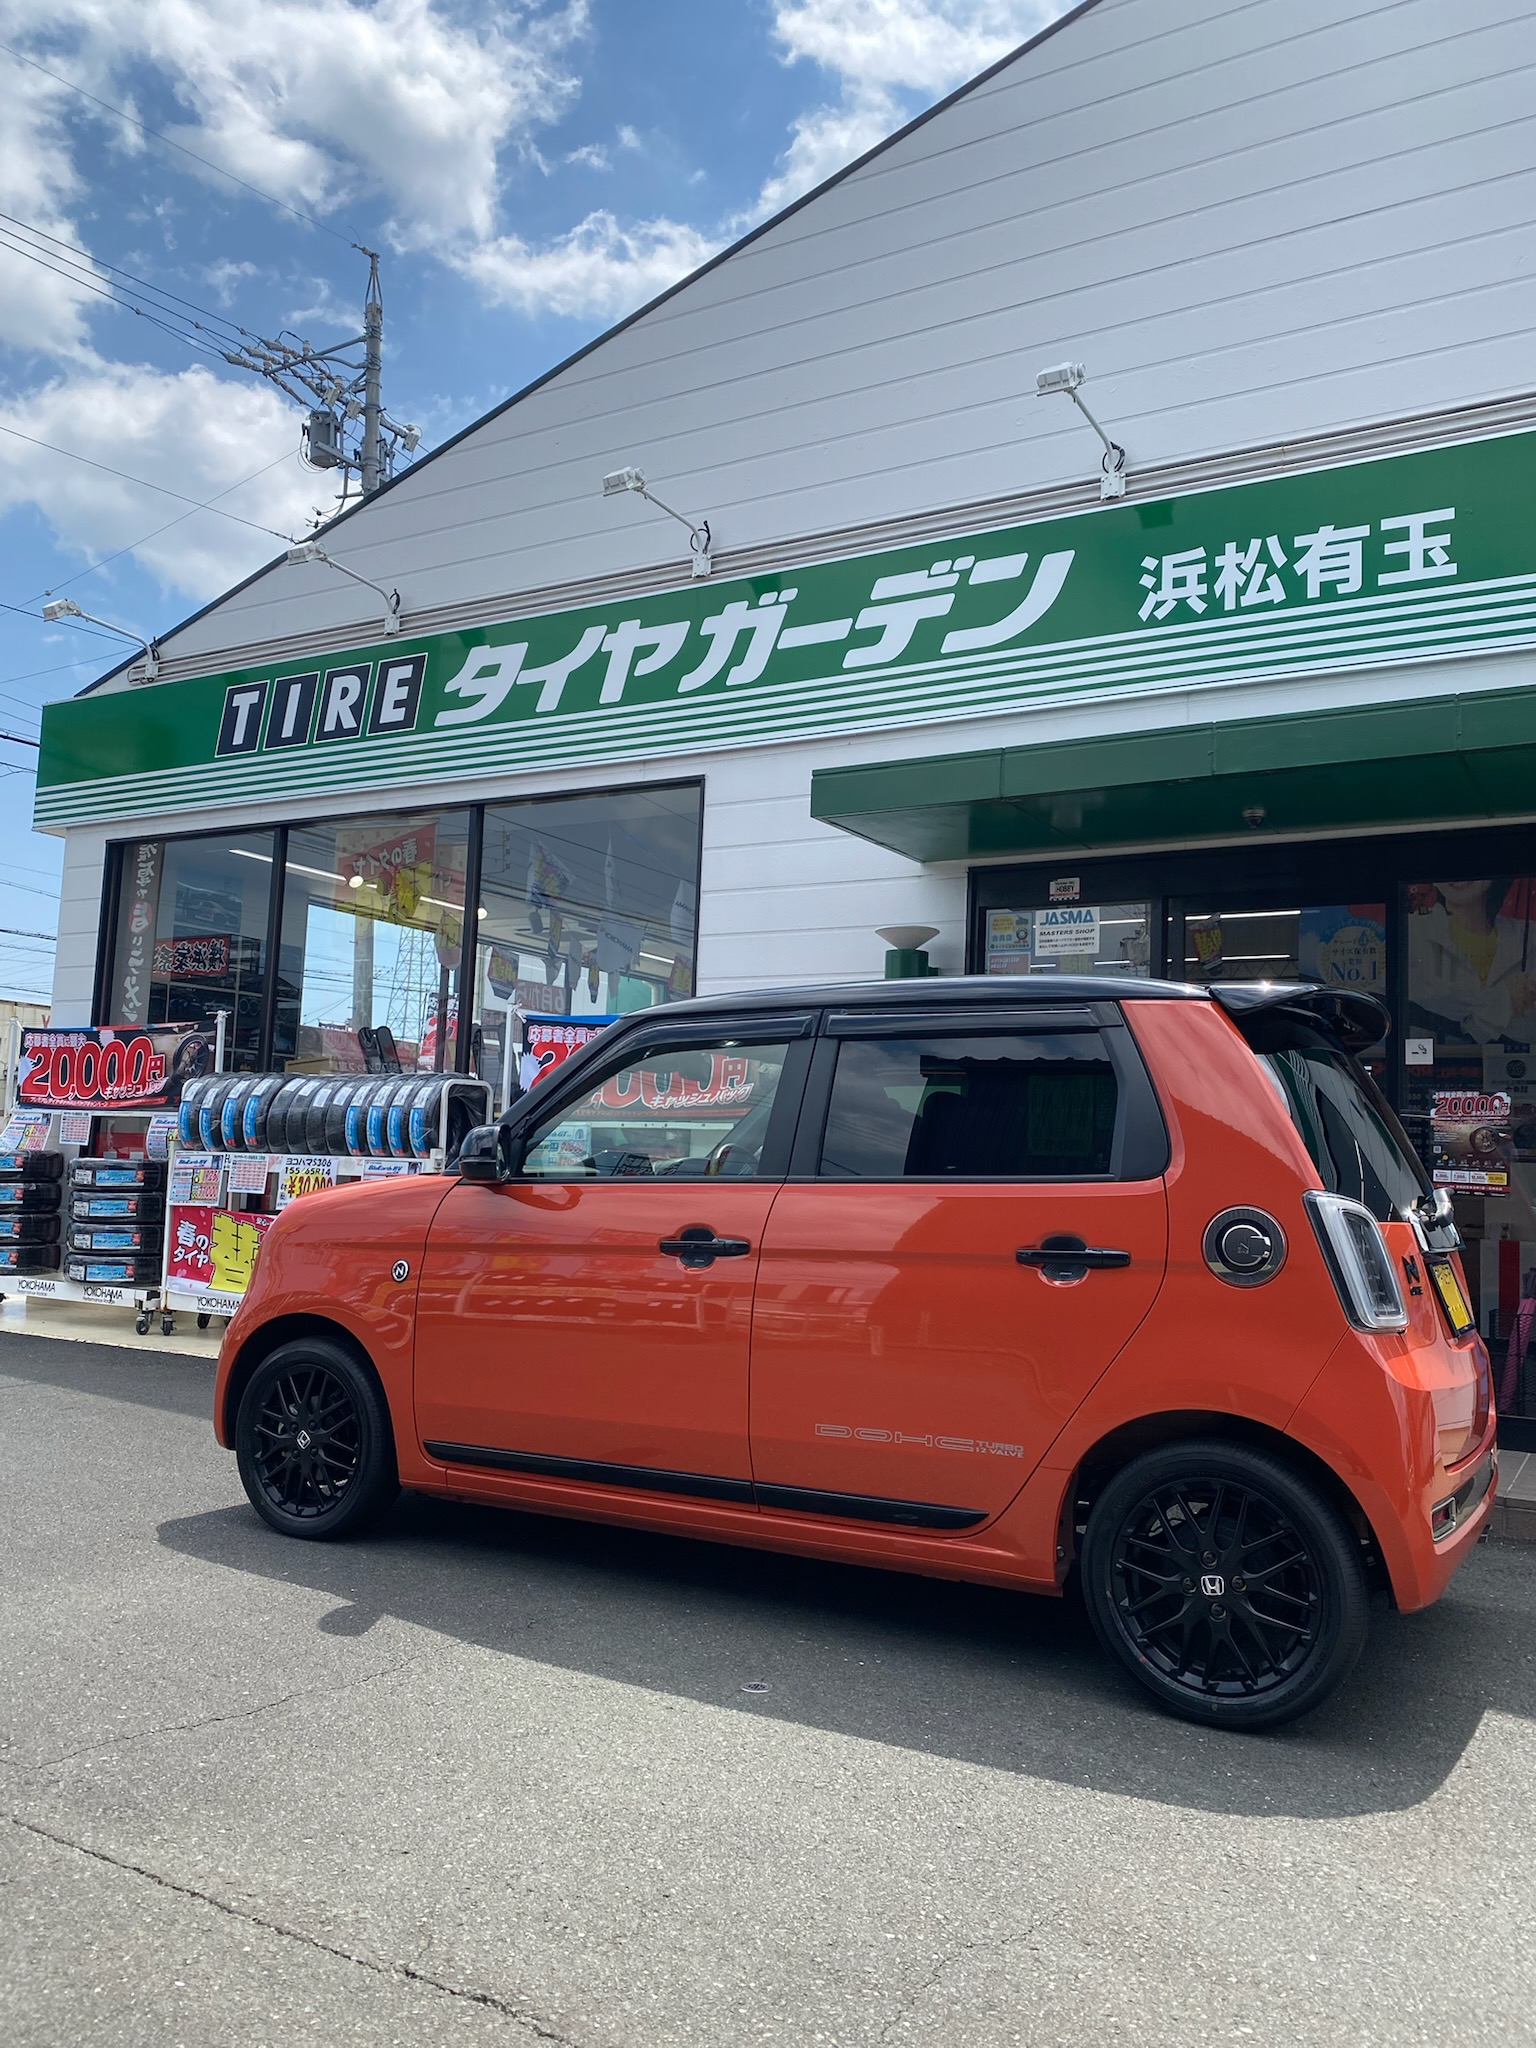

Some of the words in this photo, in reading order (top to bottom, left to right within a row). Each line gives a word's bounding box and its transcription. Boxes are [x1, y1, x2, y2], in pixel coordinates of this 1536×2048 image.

[231, 663, 414, 746] TIRE
[434, 549, 1076, 727] タイヤガーデン
[1137, 507, 1458, 622] 浜松有玉
[1040, 910, 1094, 925] JASMA
[1329, 960, 1377, 981] No.1
[651, 1083, 754, 1109] キャッシュバック
[285, 1157, 332, 1167] ヨコハマS306
[284, 1166, 331, 1176] 155/65R14
[177, 1220, 209, 1250] 春の
[173, 1246, 208, 1268] タイヤ
[17, 1279, 56, 1292] YOKOHAMA
[83, 1286, 123, 1300] YOKOHAMA
[196, 1296, 240, 1310] YOKOHAMA
[815, 1423, 974, 1452] DOHC
[975, 1440, 1024, 1452] TURBO
[988, 1449, 1025, 1459] VALVE
